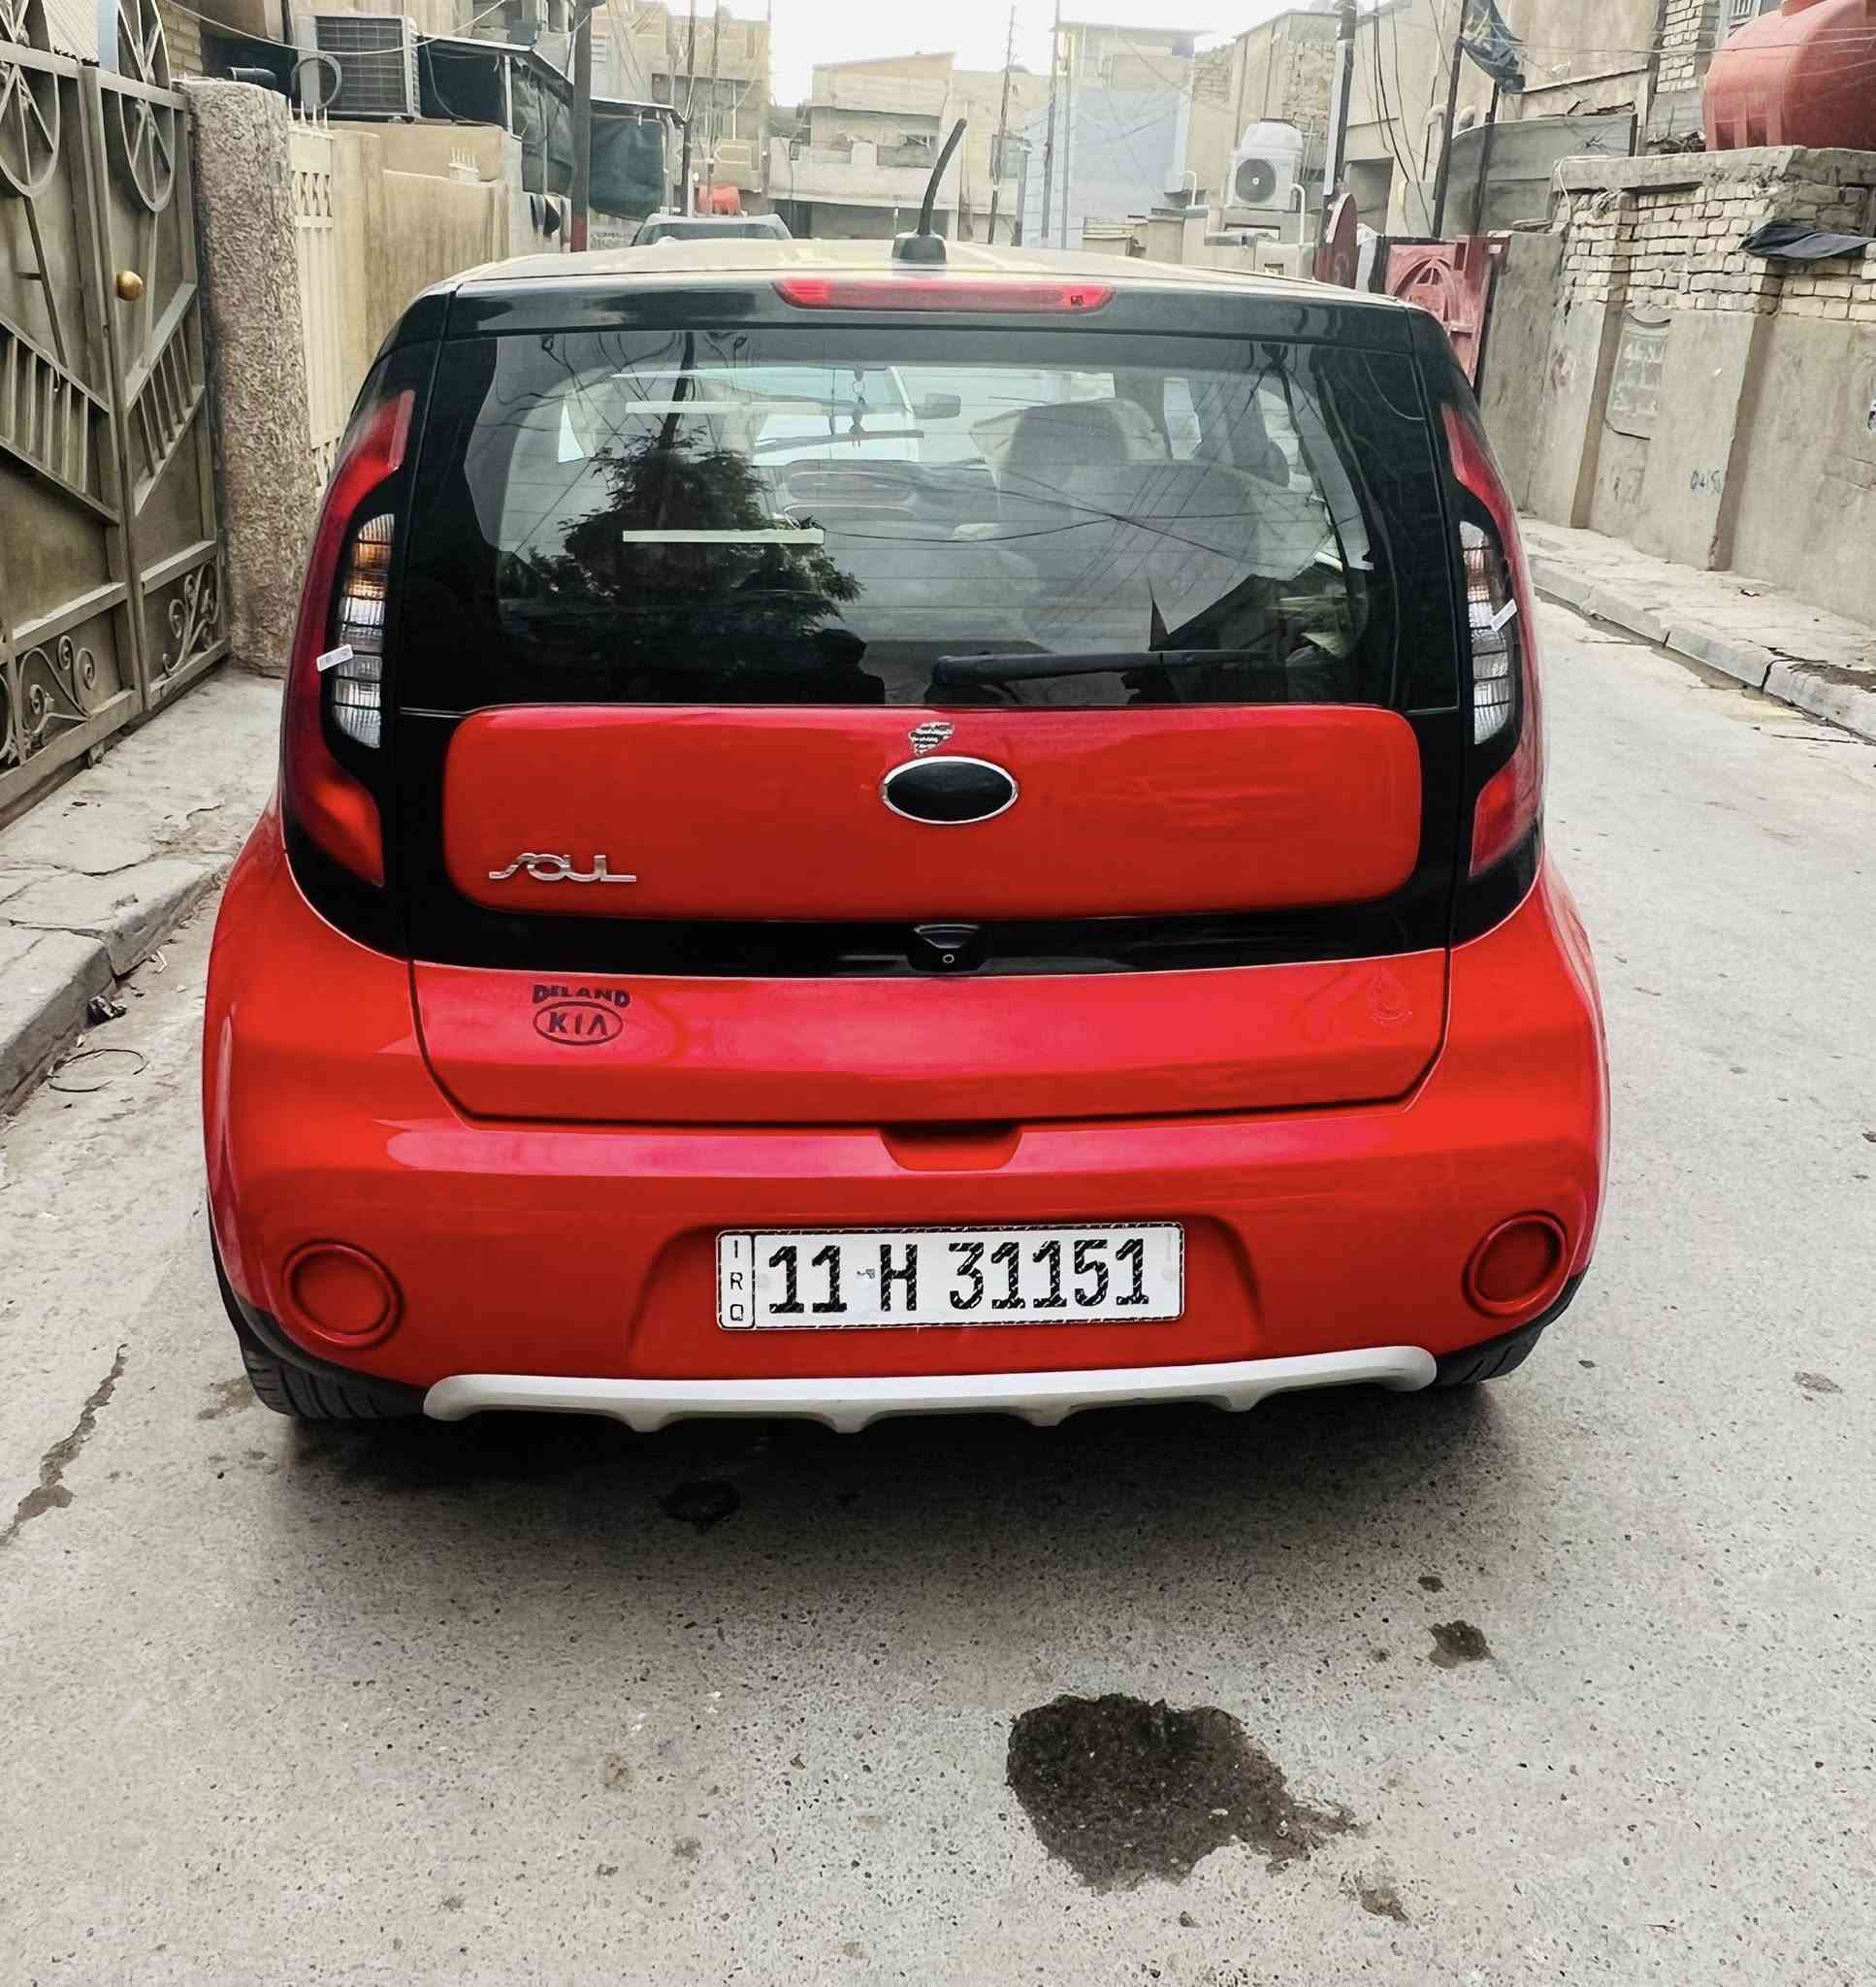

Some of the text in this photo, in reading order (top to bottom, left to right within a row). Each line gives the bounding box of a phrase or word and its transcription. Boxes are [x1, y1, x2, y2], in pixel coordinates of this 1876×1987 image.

[488, 852, 637, 883] SOUL
[548, 1011, 608, 1037] KIA
[768, 1238, 1149, 1314] 11 H 31151
